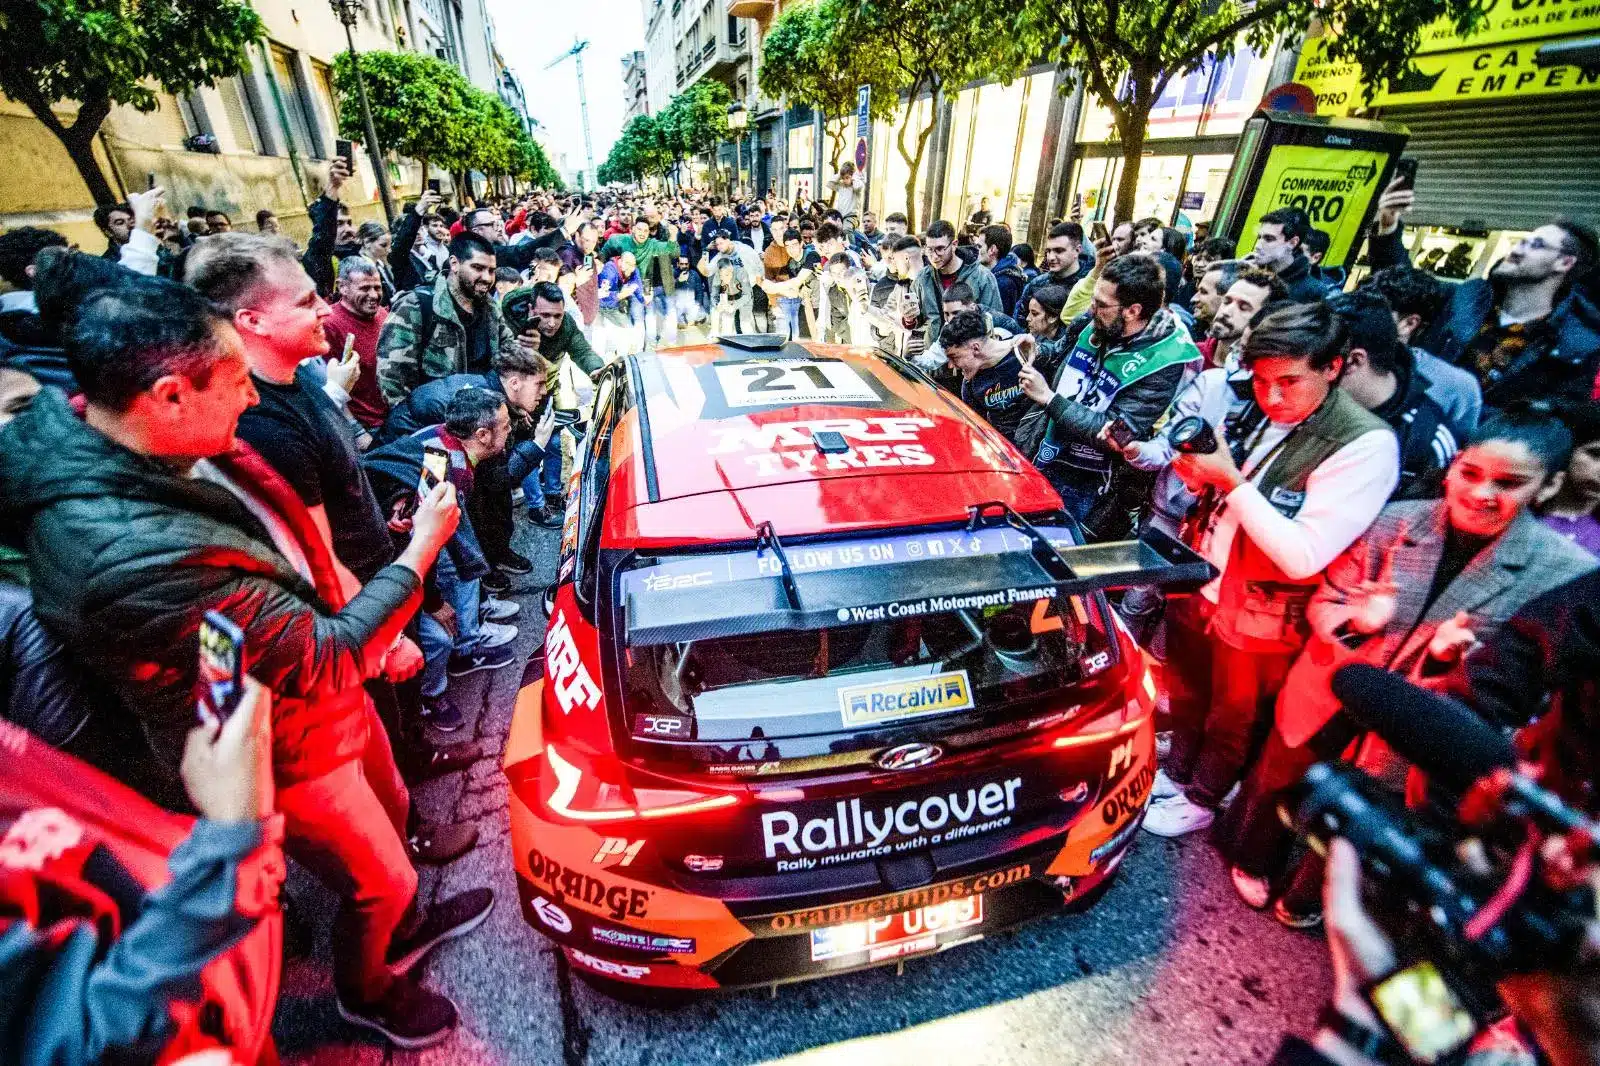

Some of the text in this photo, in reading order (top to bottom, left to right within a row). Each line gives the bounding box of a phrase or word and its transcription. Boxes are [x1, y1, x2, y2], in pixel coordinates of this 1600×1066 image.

[1501, 15, 1540, 30] CASA
[1279, 193, 1294, 205] TU
[1281, 178, 1354, 193] COMPRAMOS
[1290, 194, 1345, 223] ORO
[741, 365, 835, 392] 21
[706, 417, 936, 454] MRF
[744, 444, 936, 477] TYRES
[758, 549, 833, 575] FOLOW
[839, 547, 865, 564] US
[869, 543, 895, 561] ON
[850, 586, 1057, 622] West Coast Motorsport Finance
[547, 608, 603, 715] MRF
[871, 684, 943, 713] Recalvi
[1108, 738, 1134, 779] P1
[1102, 765, 1151, 825] ORAN
[761, 777, 1022, 859] Rallycover
[592, 837, 647, 867] P1
[777, 816, 1012, 873] Rally insurance with a difference
[528, 848, 650, 920] ORANGE
[770, 863, 1031, 931] orangeamps.com
